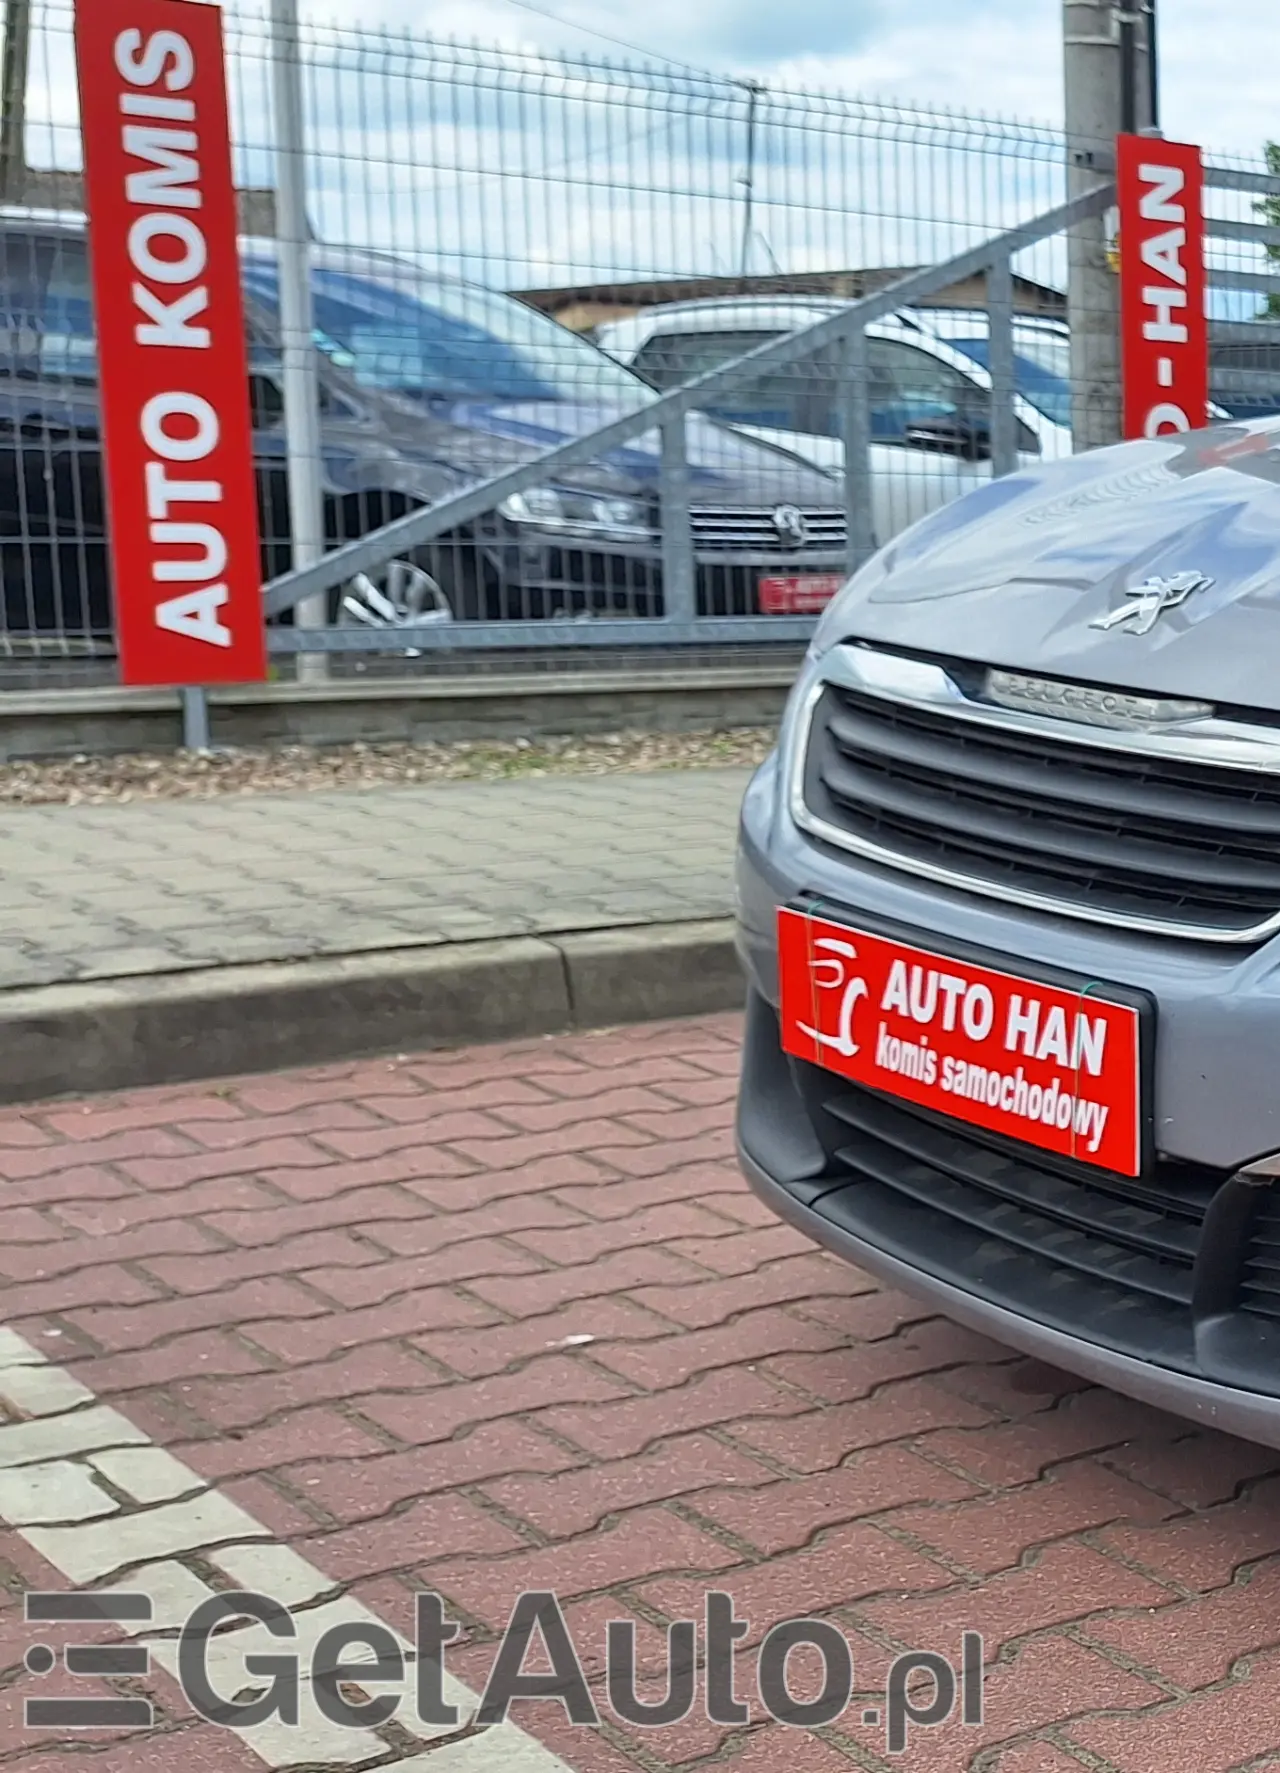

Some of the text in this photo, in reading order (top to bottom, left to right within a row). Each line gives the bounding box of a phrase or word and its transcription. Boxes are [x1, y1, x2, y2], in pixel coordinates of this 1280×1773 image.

[1138, 163, 1189, 343] HAN
[114, 27, 233, 648] AUTO KOMIS
[875, 1020, 1109, 1153] komis samochodowy
[880, 958, 1108, 1077] AUTO HAN
